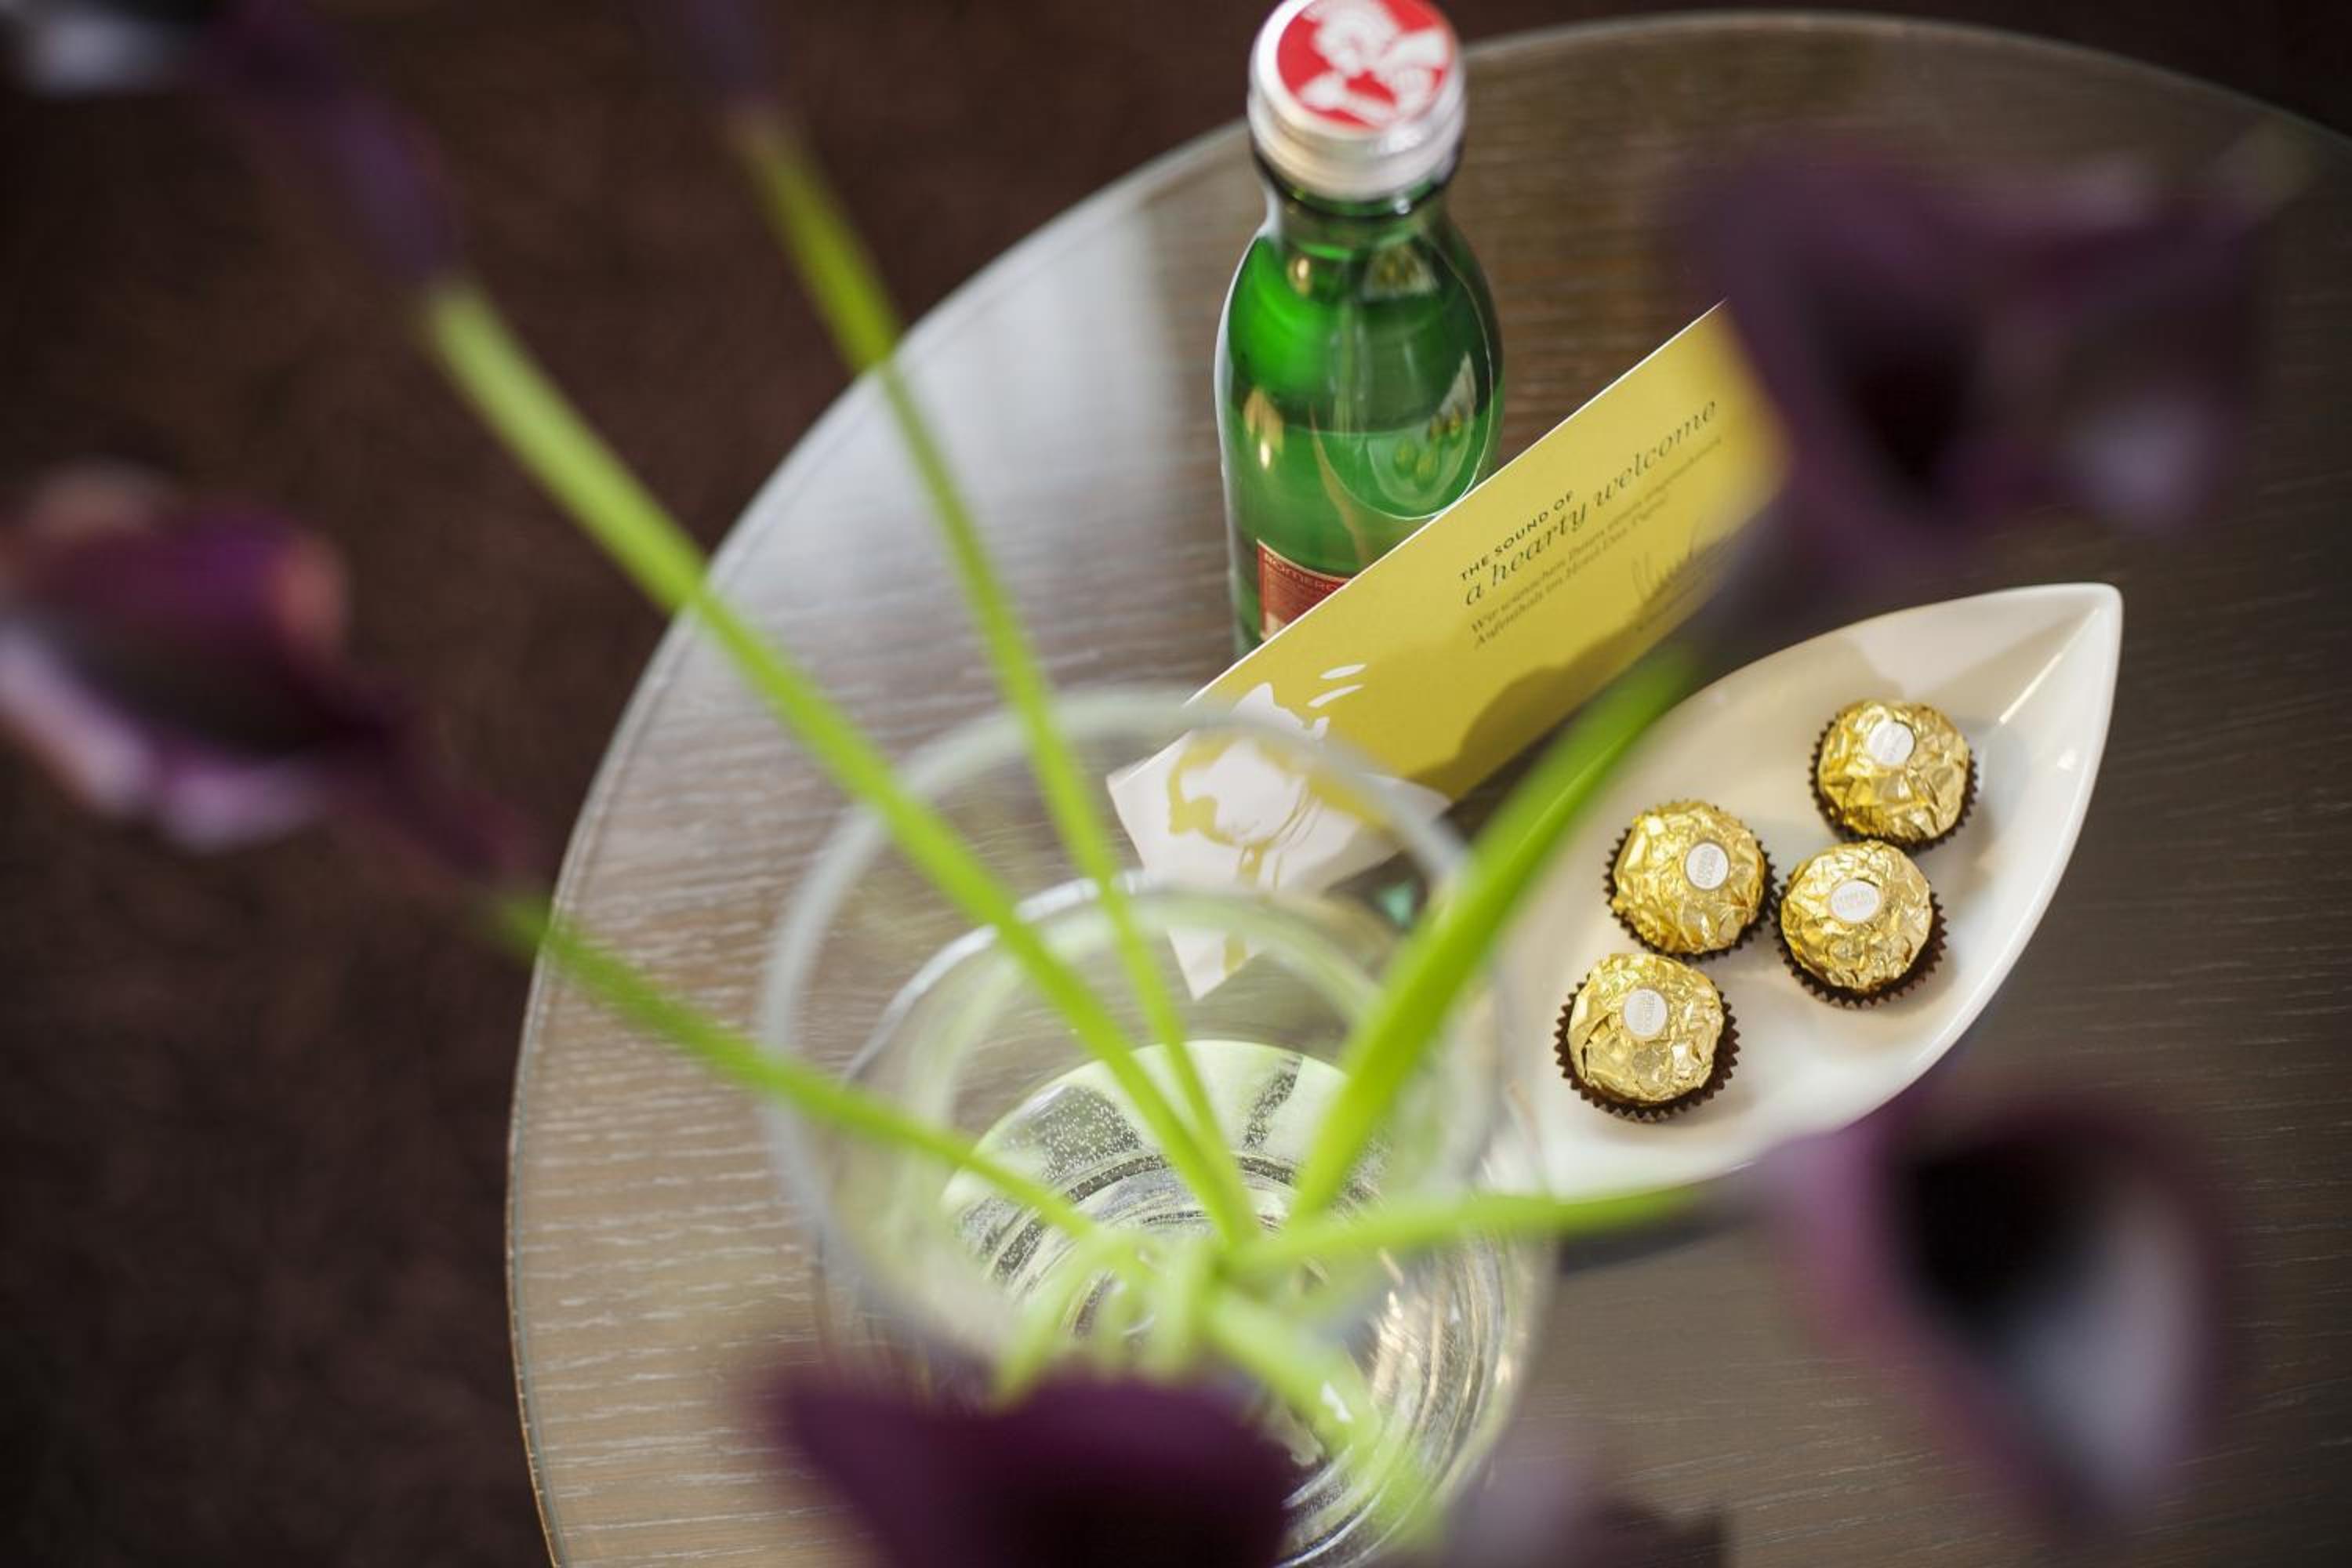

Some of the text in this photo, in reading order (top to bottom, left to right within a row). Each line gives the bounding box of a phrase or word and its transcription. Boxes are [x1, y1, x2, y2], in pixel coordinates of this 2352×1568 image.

[1461, 491, 1573, 580] THE SOUND OF
[1466, 581, 1483, 605] a
[1492, 502, 1586, 586] hearty
[1594, 401, 1716, 506] welcome
